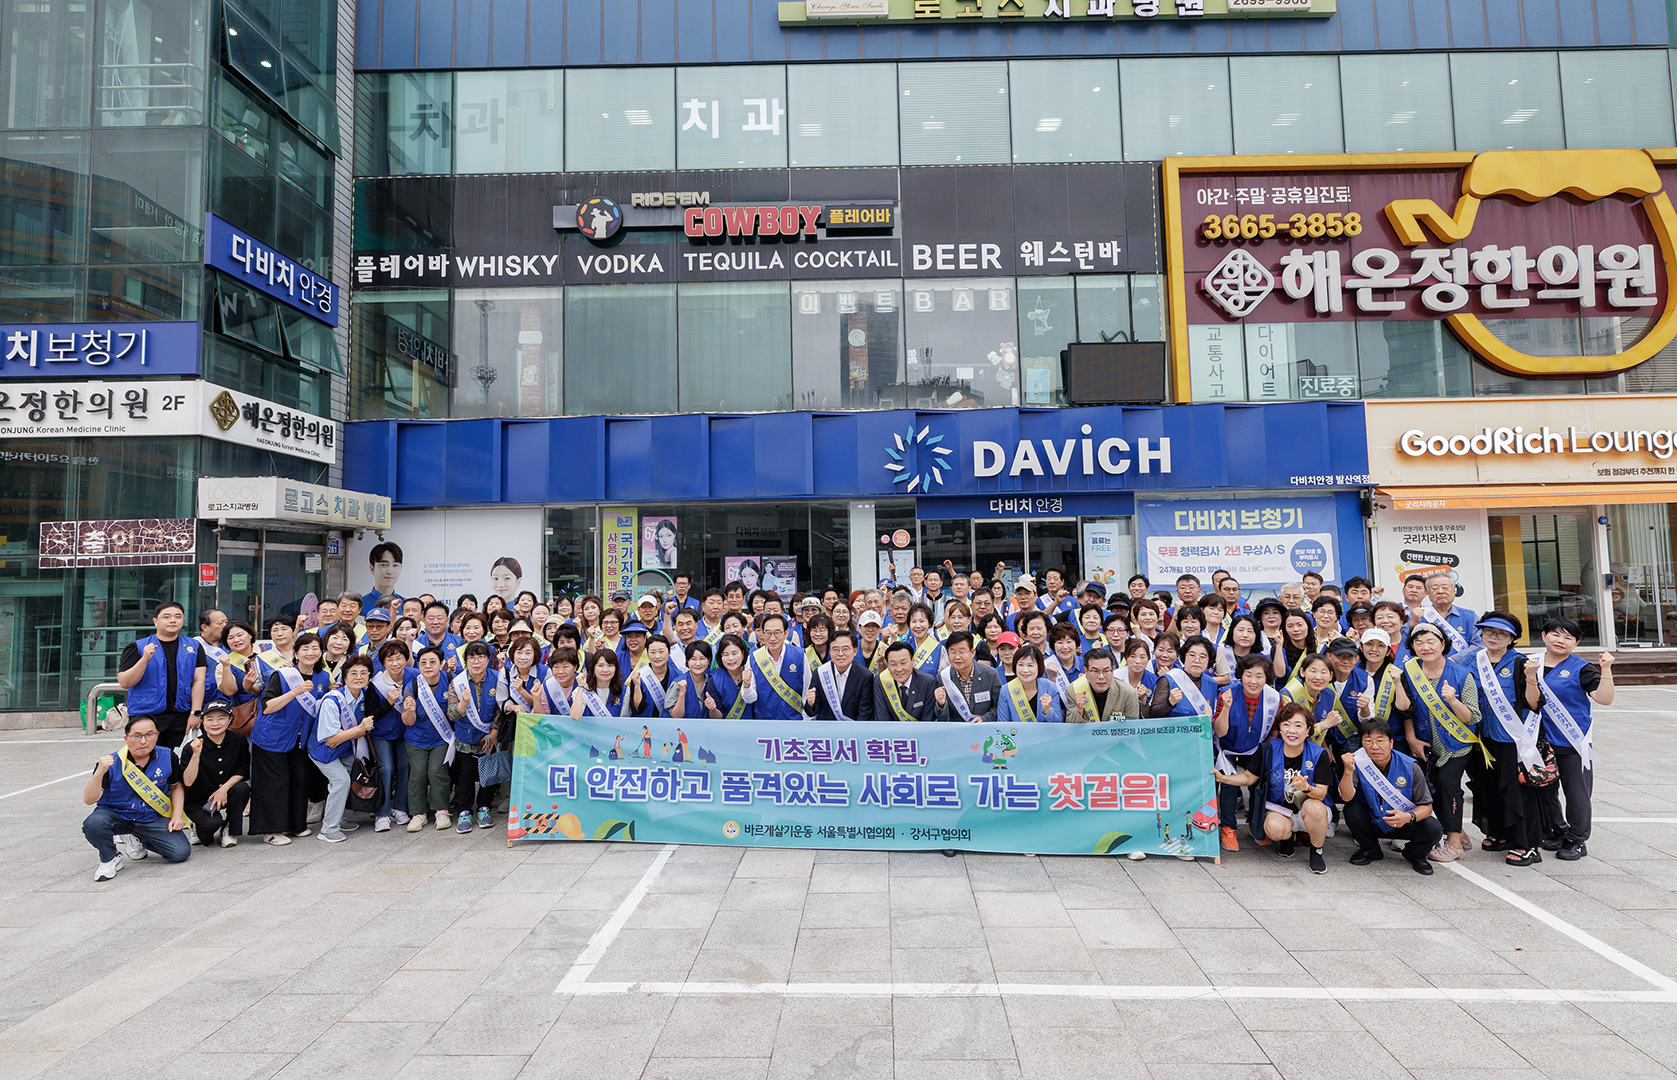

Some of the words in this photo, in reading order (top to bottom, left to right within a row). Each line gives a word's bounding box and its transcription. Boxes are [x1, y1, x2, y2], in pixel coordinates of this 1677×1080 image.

[810, 2, 837, 11] Change
[840, 1, 862, 11] Your
[868, 1, 884, 9] Smile
[682, 98, 784, 138] 치과
[684, 206, 821, 236] COWBOY
[829, 208, 891, 224] 플레어바
[1203, 212, 1362, 239] 3665-3858
[455, 254, 558, 277] WHISKY
[577, 254, 664, 274] VODKA
[684, 251, 785, 271] TEQUILA
[794, 250, 898, 272] COCKTAIL
[913, 244, 1002, 271] BEER
[1020, 240, 1121, 269] 웨스턴바
[354, 253, 449, 282] 플레어바
[1280, 244, 1658, 313] 해온정한의원
[45, 329, 146, 366] 보청기
[1207, 326, 1225, 398] 교통사고
[1258, 324, 1277, 397] 다이어트
[1302, 376, 1355, 397] 진료중
[162, 395, 186, 411] 2F
[104, 425, 126, 433] Clinic
[242, 402, 334, 447] 해온정한의원
[1400, 427, 1563, 456] GoodRich
[1569, 427, 1677, 459] Loung
[1290, 476, 1334, 485] 다비치안경
[1335, 474, 1370, 484] 발산역점
[207, 503, 258, 511] 로고스치과병원
[284, 487, 328, 516] 로고스
[333, 495, 360, 520] 치과
[363, 501, 386, 523] 병원
[989, 498, 1032, 514] 다비치
[1036, 498, 1063, 513] 안경
[1405, 500, 1446, 508] 굿리치라운지
[1174, 509, 1236, 531] 다비치
[1240, 508, 1303, 529] 보청기
[1403, 533, 1457, 544] 굿리치라운지
[607, 532, 618, 576] 사용가능
[1158, 546, 1178, 557] 무료
[1180, 546, 1220, 557] 청력검사
[1224, 546, 1241, 556] 2년
[1420, 684, 1468, 741] 바르게살기운동
[757, 739, 858, 763] 기초질서
[865, 737, 928, 766] 확립,
[548, 765, 577, 799] 더
[587, 766, 713, 802] 안전하고
[721, 770, 850, 806] 품격있는
[858, 773, 961, 808] 사회로
[968, 774, 1039, 810] 가는
[1049, 773, 1172, 811] 첫걸음!
[744, 824, 813, 839] 바르게살기운동
[817, 826, 895, 840] 서울특별시협의회
[910, 827, 971, 841] 강서구협의회
